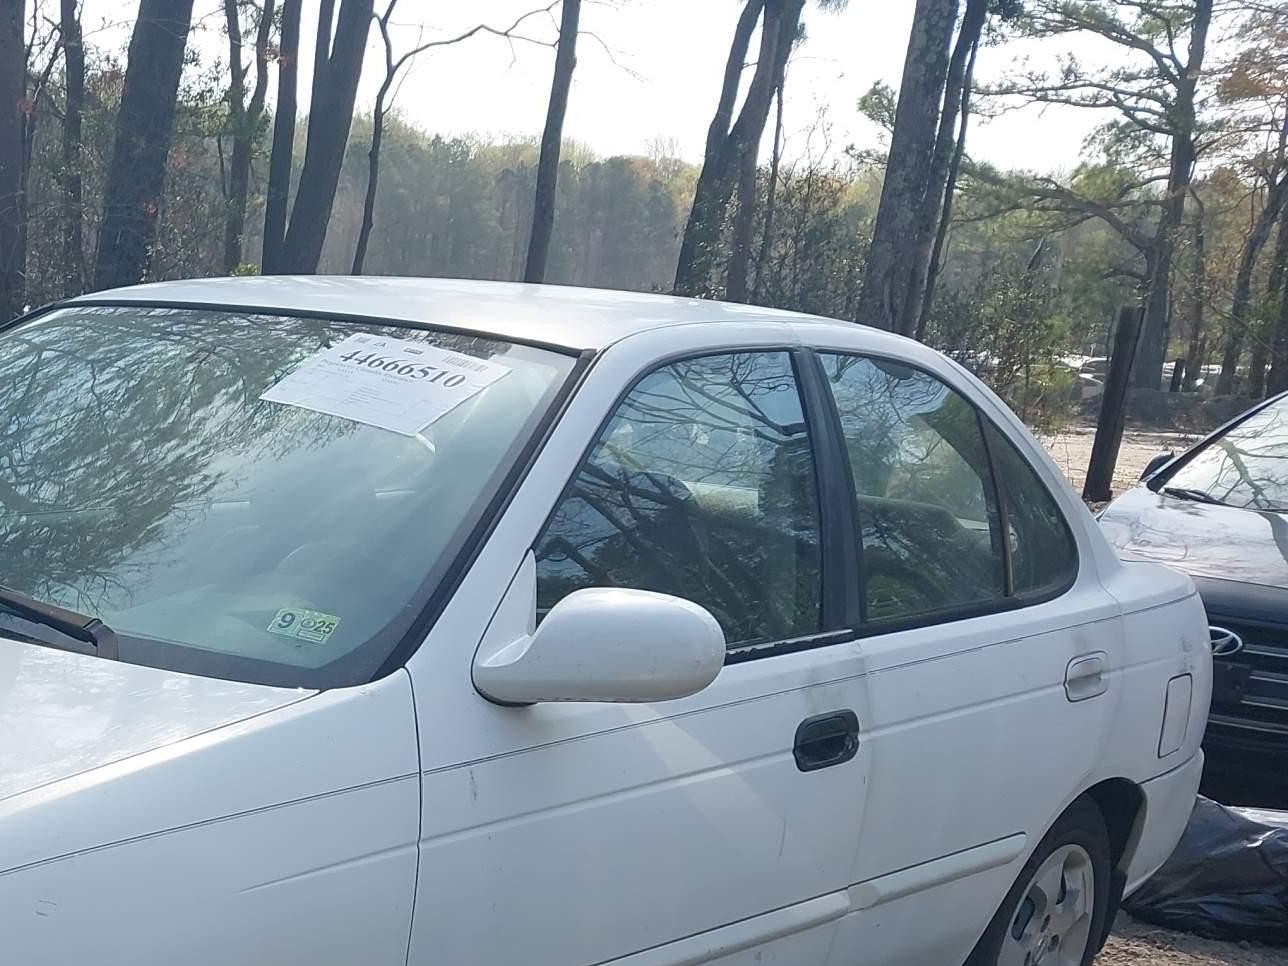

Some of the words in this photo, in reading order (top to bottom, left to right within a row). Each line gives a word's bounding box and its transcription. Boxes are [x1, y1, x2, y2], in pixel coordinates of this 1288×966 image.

[339, 350, 466, 388] 44666510
[278, 612, 296, 629] 9
[313, 620, 336, 635] 25
